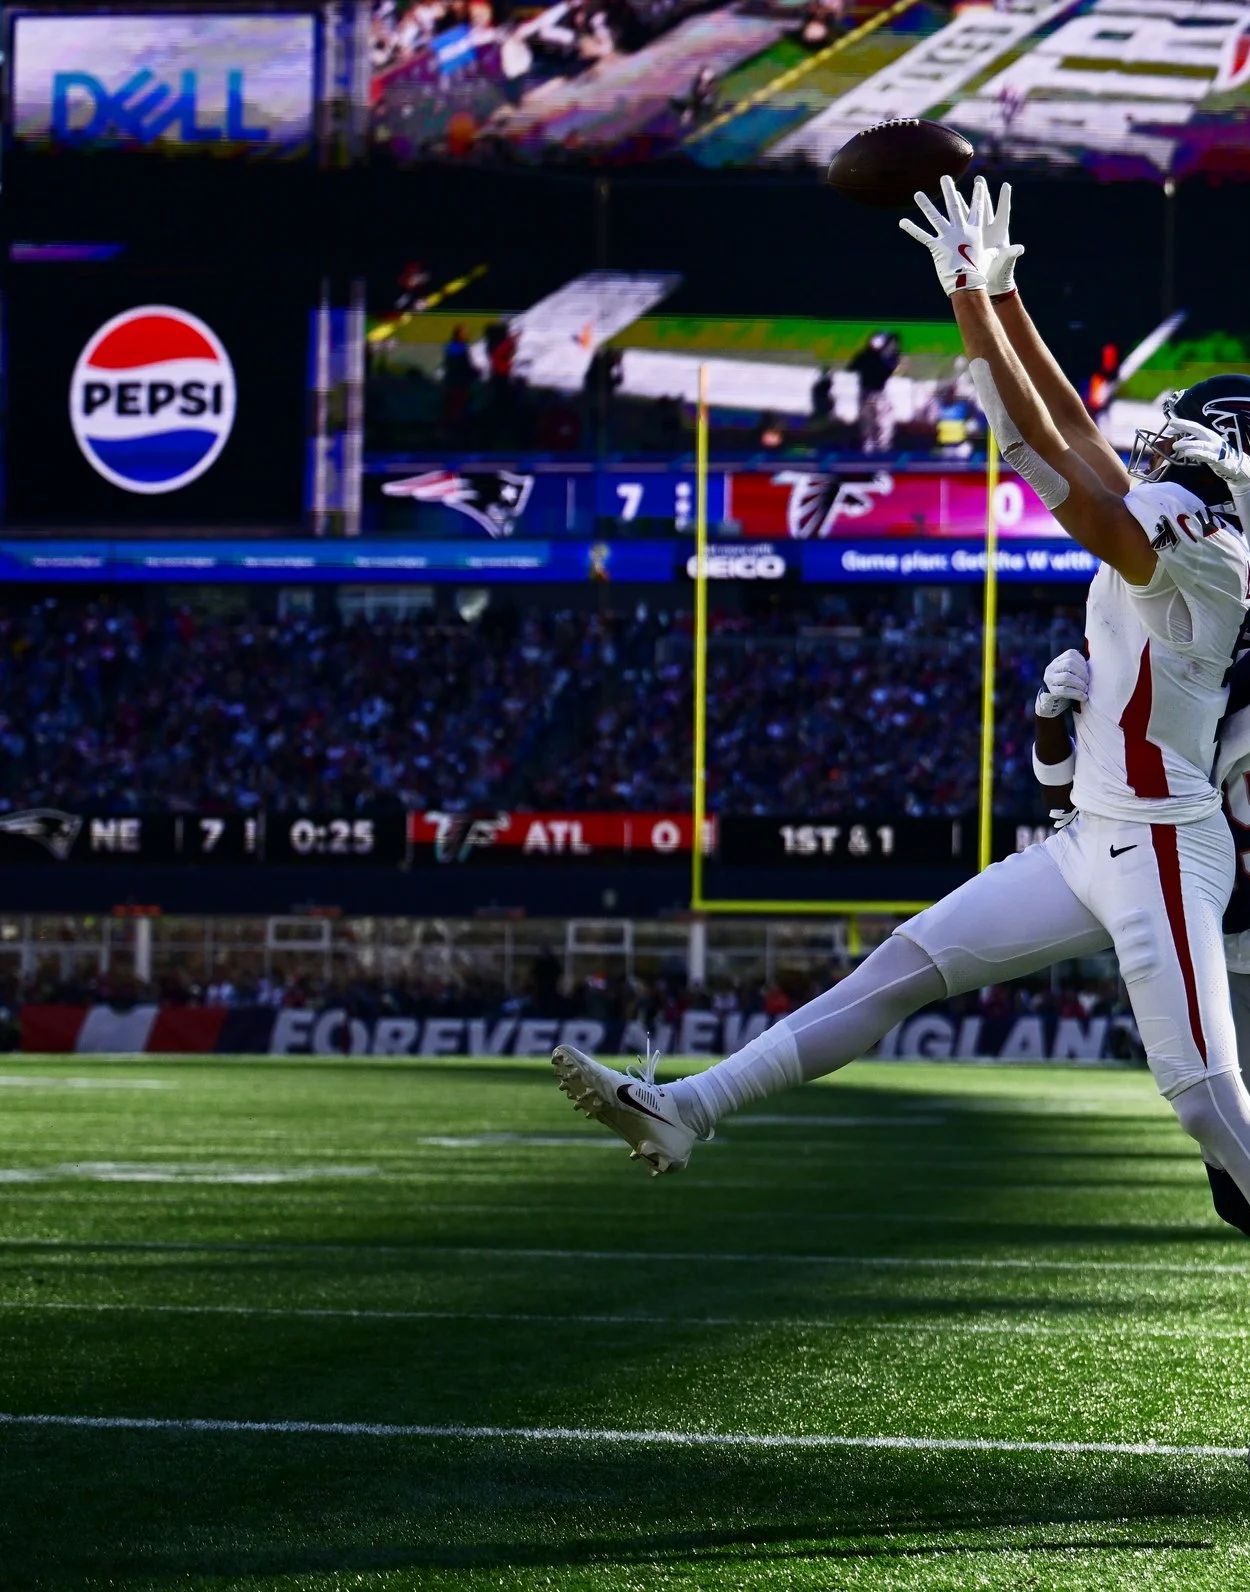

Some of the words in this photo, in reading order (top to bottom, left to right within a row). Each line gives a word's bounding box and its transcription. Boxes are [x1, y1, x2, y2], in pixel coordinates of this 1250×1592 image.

[52, 67, 269, 142] DELL
[82, 381, 223, 416] PEPSI
[616, 482, 644, 521] 7
[992, 481, 1024, 527] 0
[841, 550, 899, 572] Game
[89, 818, 143, 853] NE
[199, 818, 226, 854] 7
[289, 818, 376, 854] 0:25
[524, 821, 591, 854] ATL
[650, 821, 681, 853] 0
[778, 824, 843, 855] 1ST
[848, 824, 872, 856] &
[875, 824, 896, 856] 1
[269, 1008, 606, 1057] FOREVER
